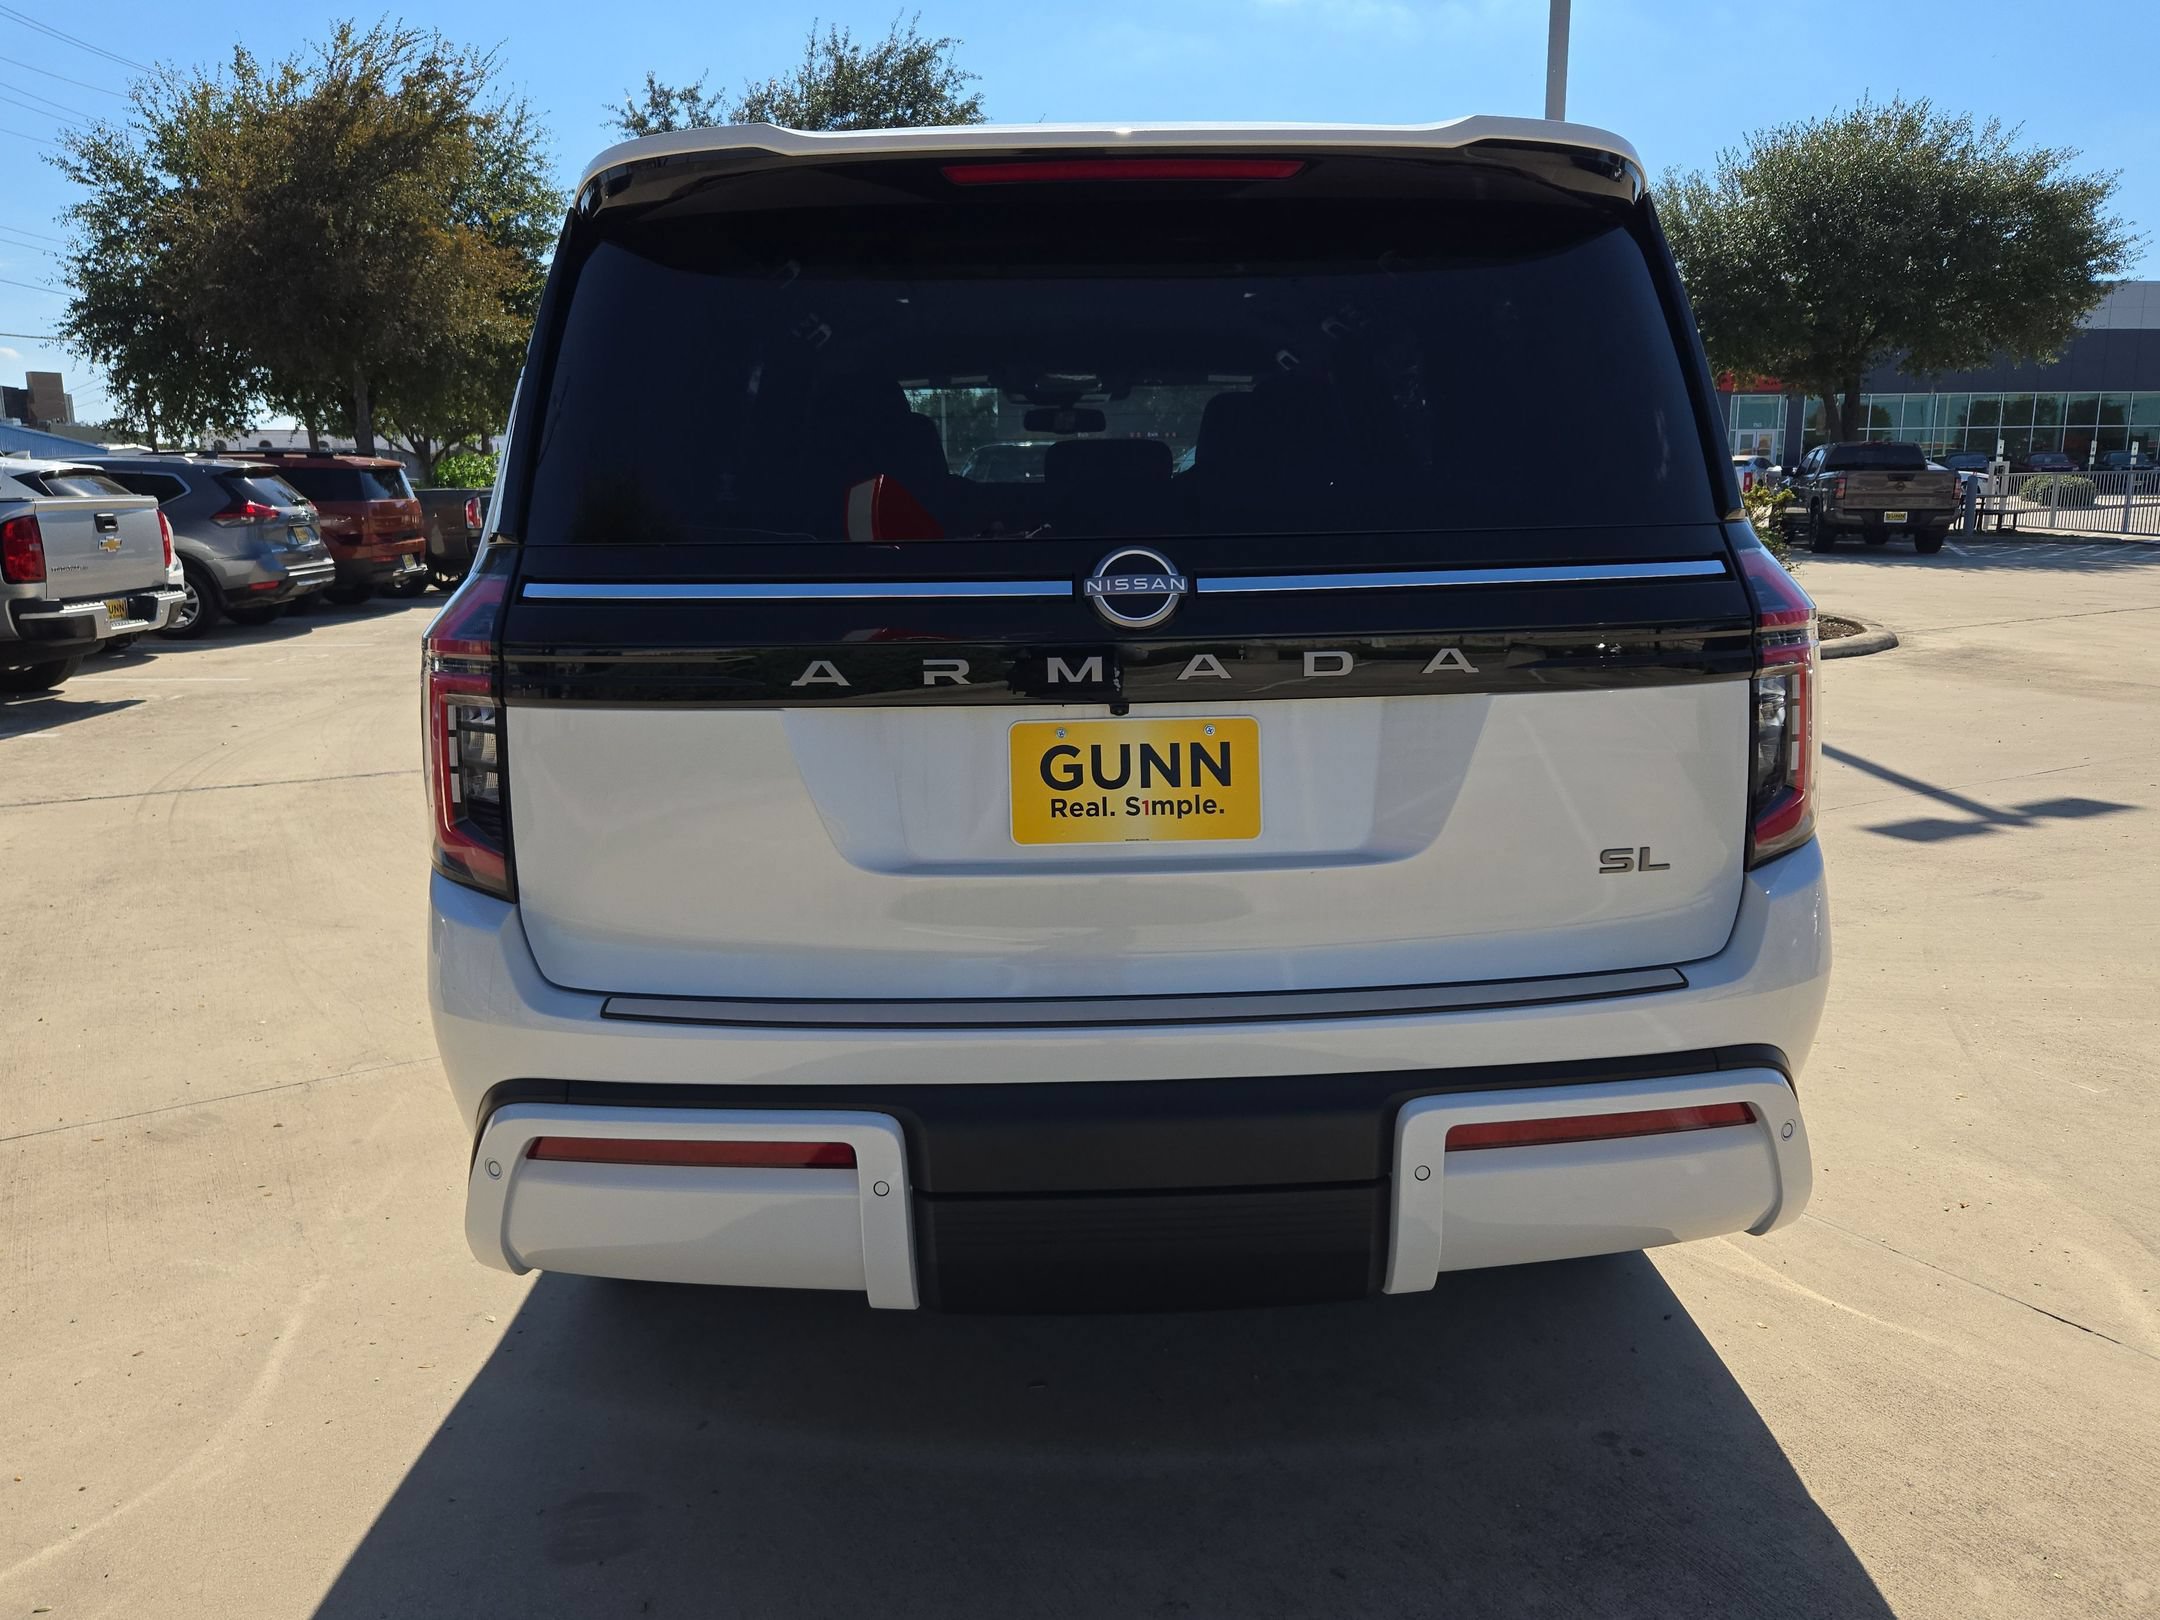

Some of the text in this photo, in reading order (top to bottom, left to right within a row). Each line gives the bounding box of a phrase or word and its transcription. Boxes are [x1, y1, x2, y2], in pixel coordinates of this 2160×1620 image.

[1087, 578, 1185, 593] NISSAN
[108, 602, 125, 614] UNN
[791, 648, 1479, 686] ARMADA
[1040, 742, 1231, 791] GUNN
[1051, 794, 1225, 819] Real. S1mple.
[1599, 846, 1671, 874] SL
